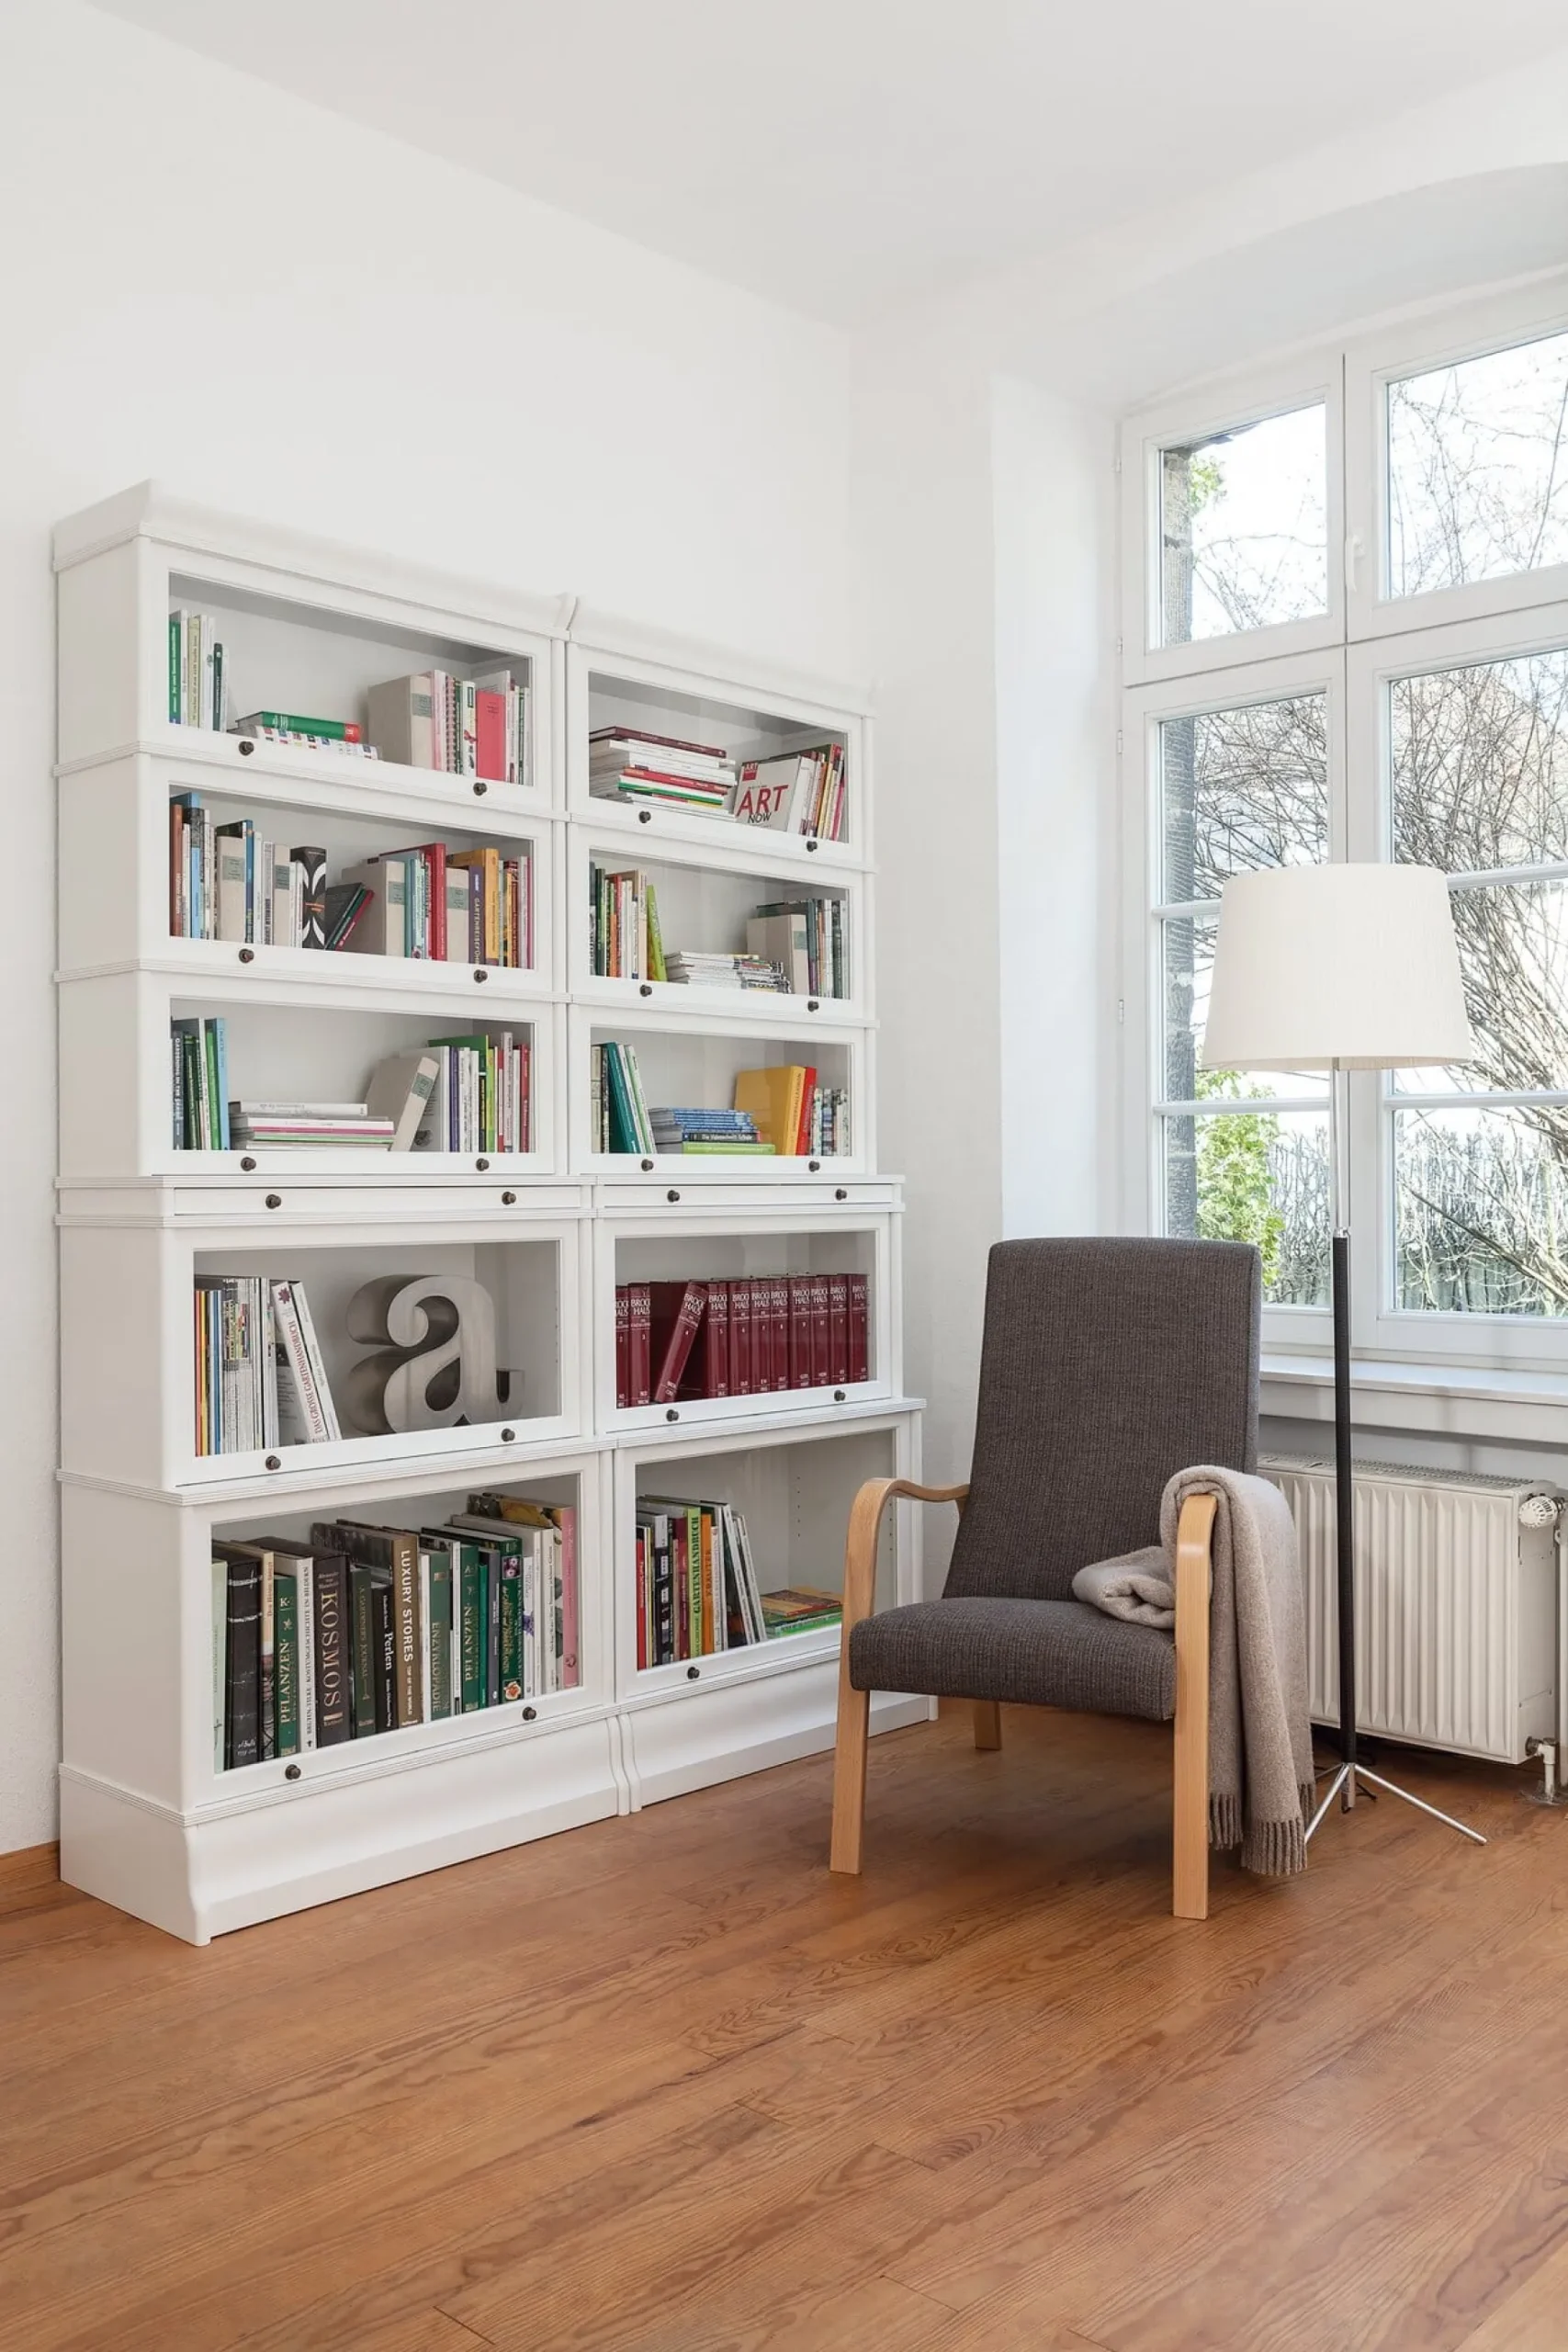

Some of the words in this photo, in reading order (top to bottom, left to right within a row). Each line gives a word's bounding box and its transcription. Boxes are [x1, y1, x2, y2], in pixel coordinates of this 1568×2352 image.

[735, 784, 789, 818] ART
[747, 812, 772, 824] NOW
[288, 1320, 313, 1392] GARTENHANDBUCH
[383, 1274, 525, 1433] a
[400, 1550, 412, 1603] LUXURY
[691, 1516, 701, 1614] GARTENHANDBUCH
[321, 1592, 342, 1708] KOSMOS
[384, 1631, 395, 1671] Perlen
[402, 1609, 413, 1663] STORES
